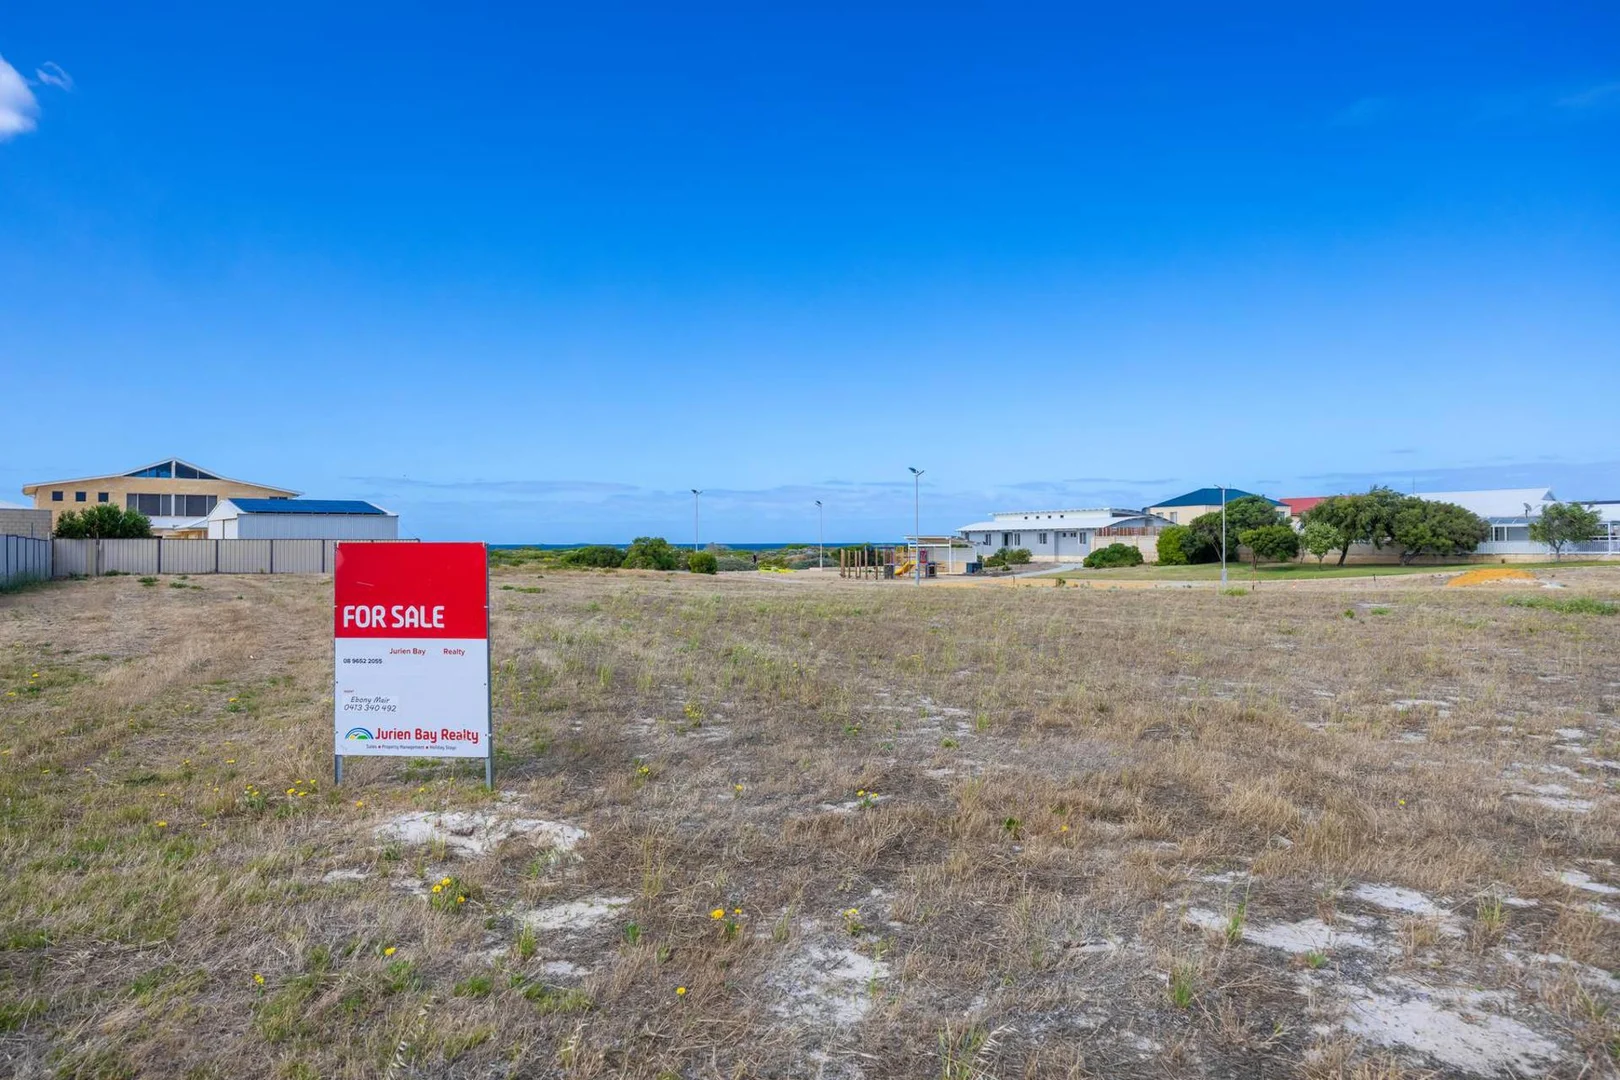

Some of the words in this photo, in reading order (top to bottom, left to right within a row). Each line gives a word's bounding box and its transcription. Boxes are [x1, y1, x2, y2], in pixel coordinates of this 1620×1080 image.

[343, 605, 387, 628] FOR
[391, 605, 445, 629] SALE
[412, 648, 426, 656] Bay
[443, 648, 465, 656] Realty
[350, 696, 372, 704] Ebony
[364, 704, 380, 712] 340
[382, 704, 397, 712] 492
[375, 728, 410, 740] Jurien
[414, 728, 437, 744] Bay
[441, 728, 478, 744] Realty
